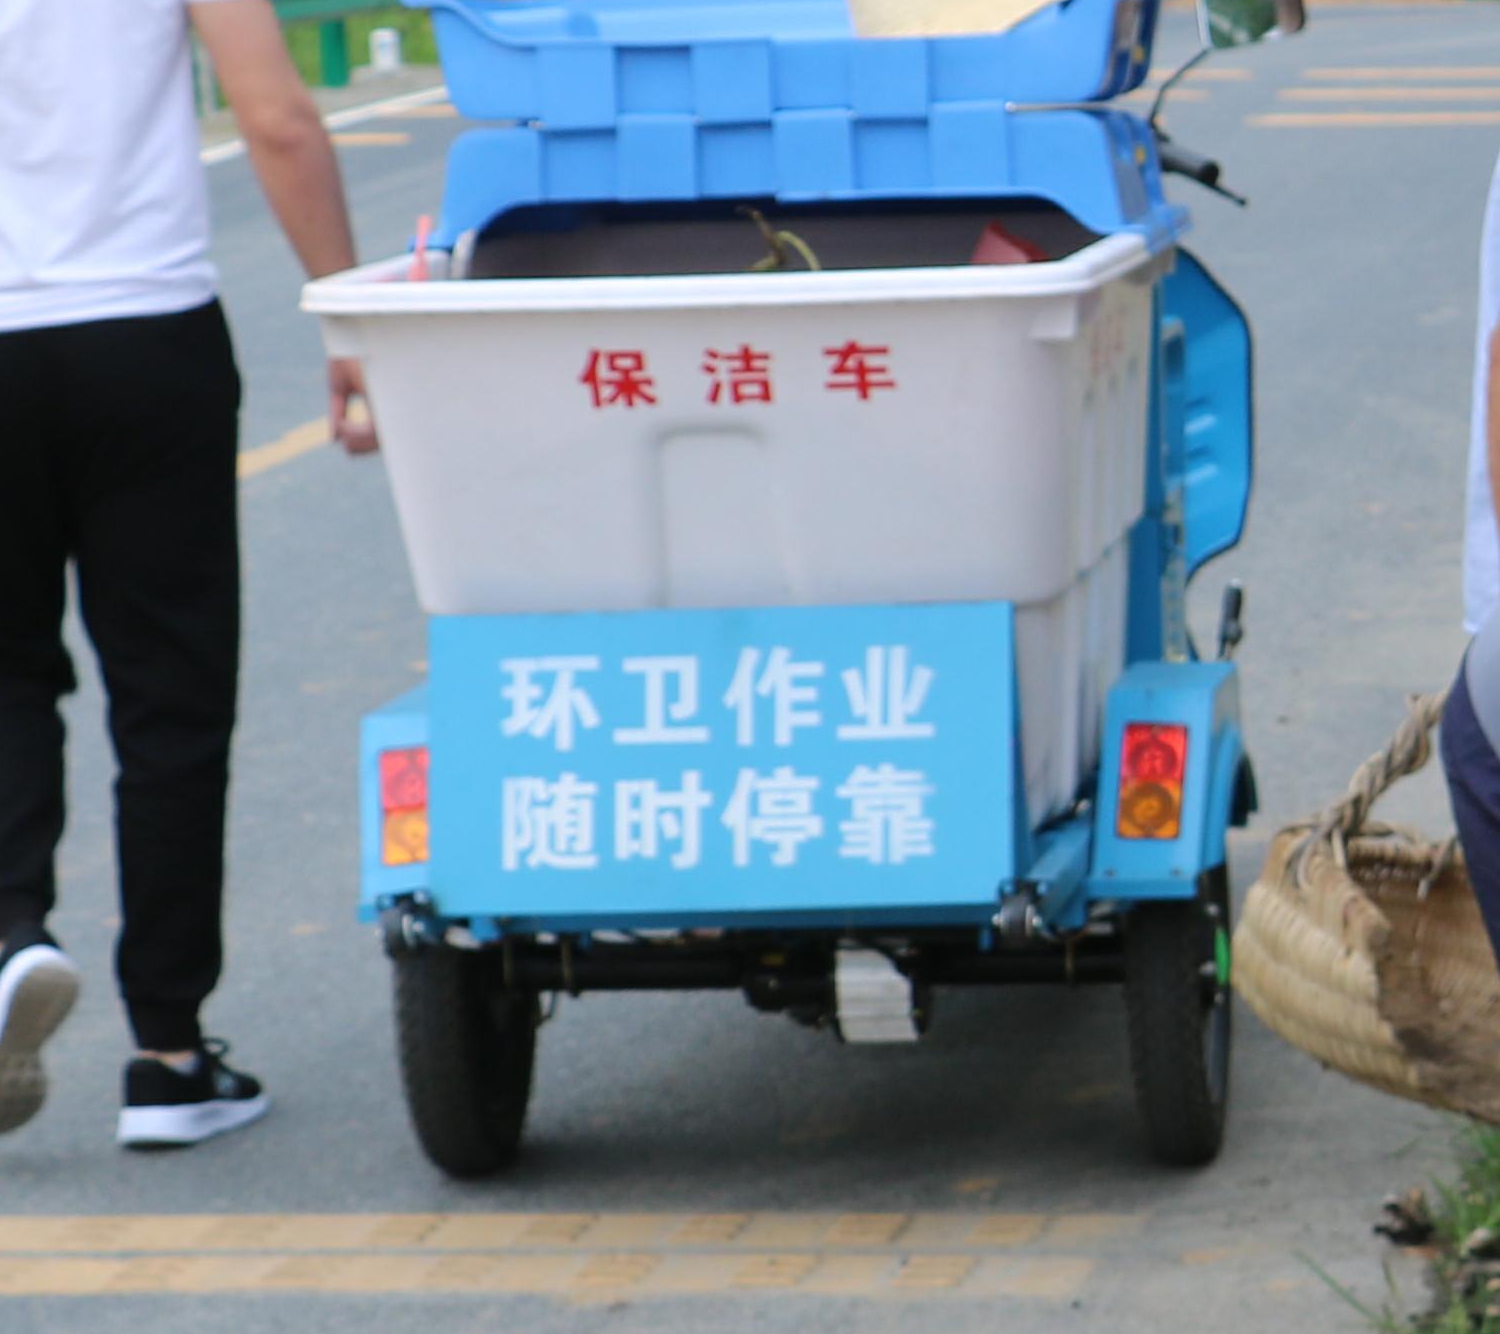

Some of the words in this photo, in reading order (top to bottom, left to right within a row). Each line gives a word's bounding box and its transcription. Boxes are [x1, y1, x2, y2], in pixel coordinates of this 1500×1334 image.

[581, 341, 896, 408] 保洁车
[501, 645, 937, 750] 环卫作业
[502, 763, 937, 870] 随时停靠
